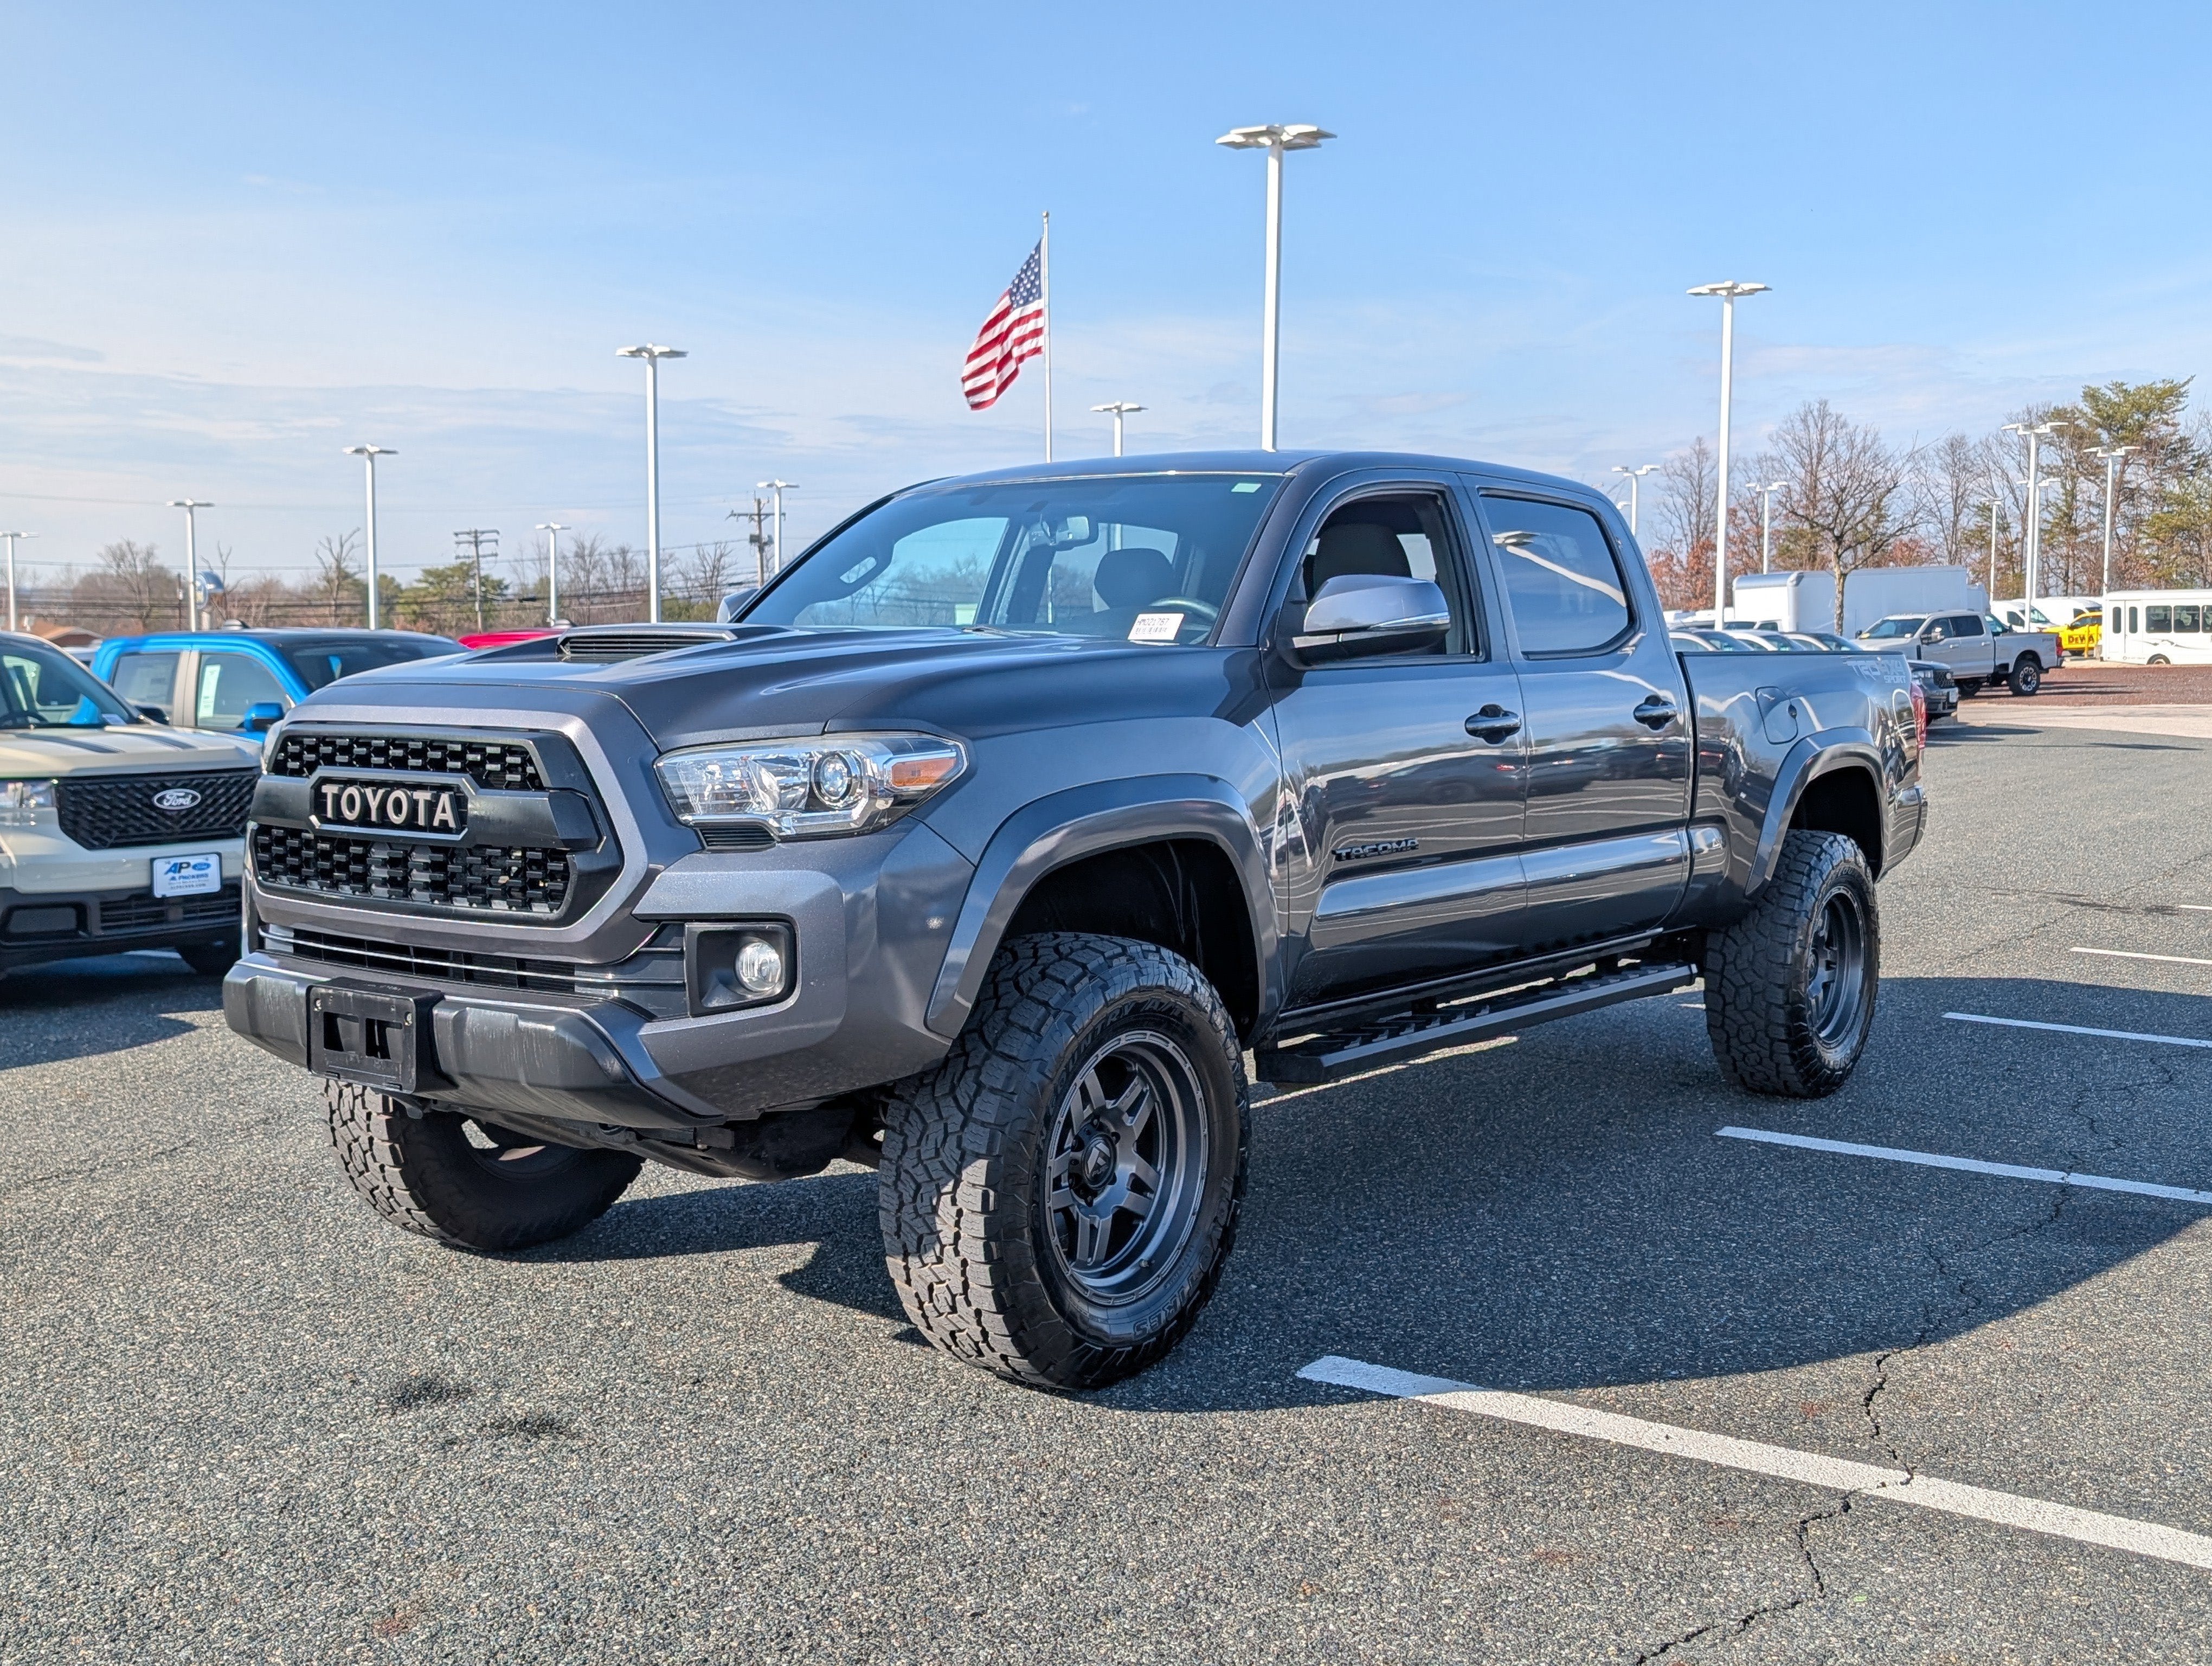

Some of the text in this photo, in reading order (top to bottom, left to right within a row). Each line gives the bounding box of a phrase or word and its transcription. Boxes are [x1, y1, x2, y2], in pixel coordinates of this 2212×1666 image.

[1883, 675, 1906, 683] SPORT
[163, 792, 192, 806] Ford
[321, 784, 456, 828] TOYOTA
[1332, 838, 1419, 861] TACOMA
